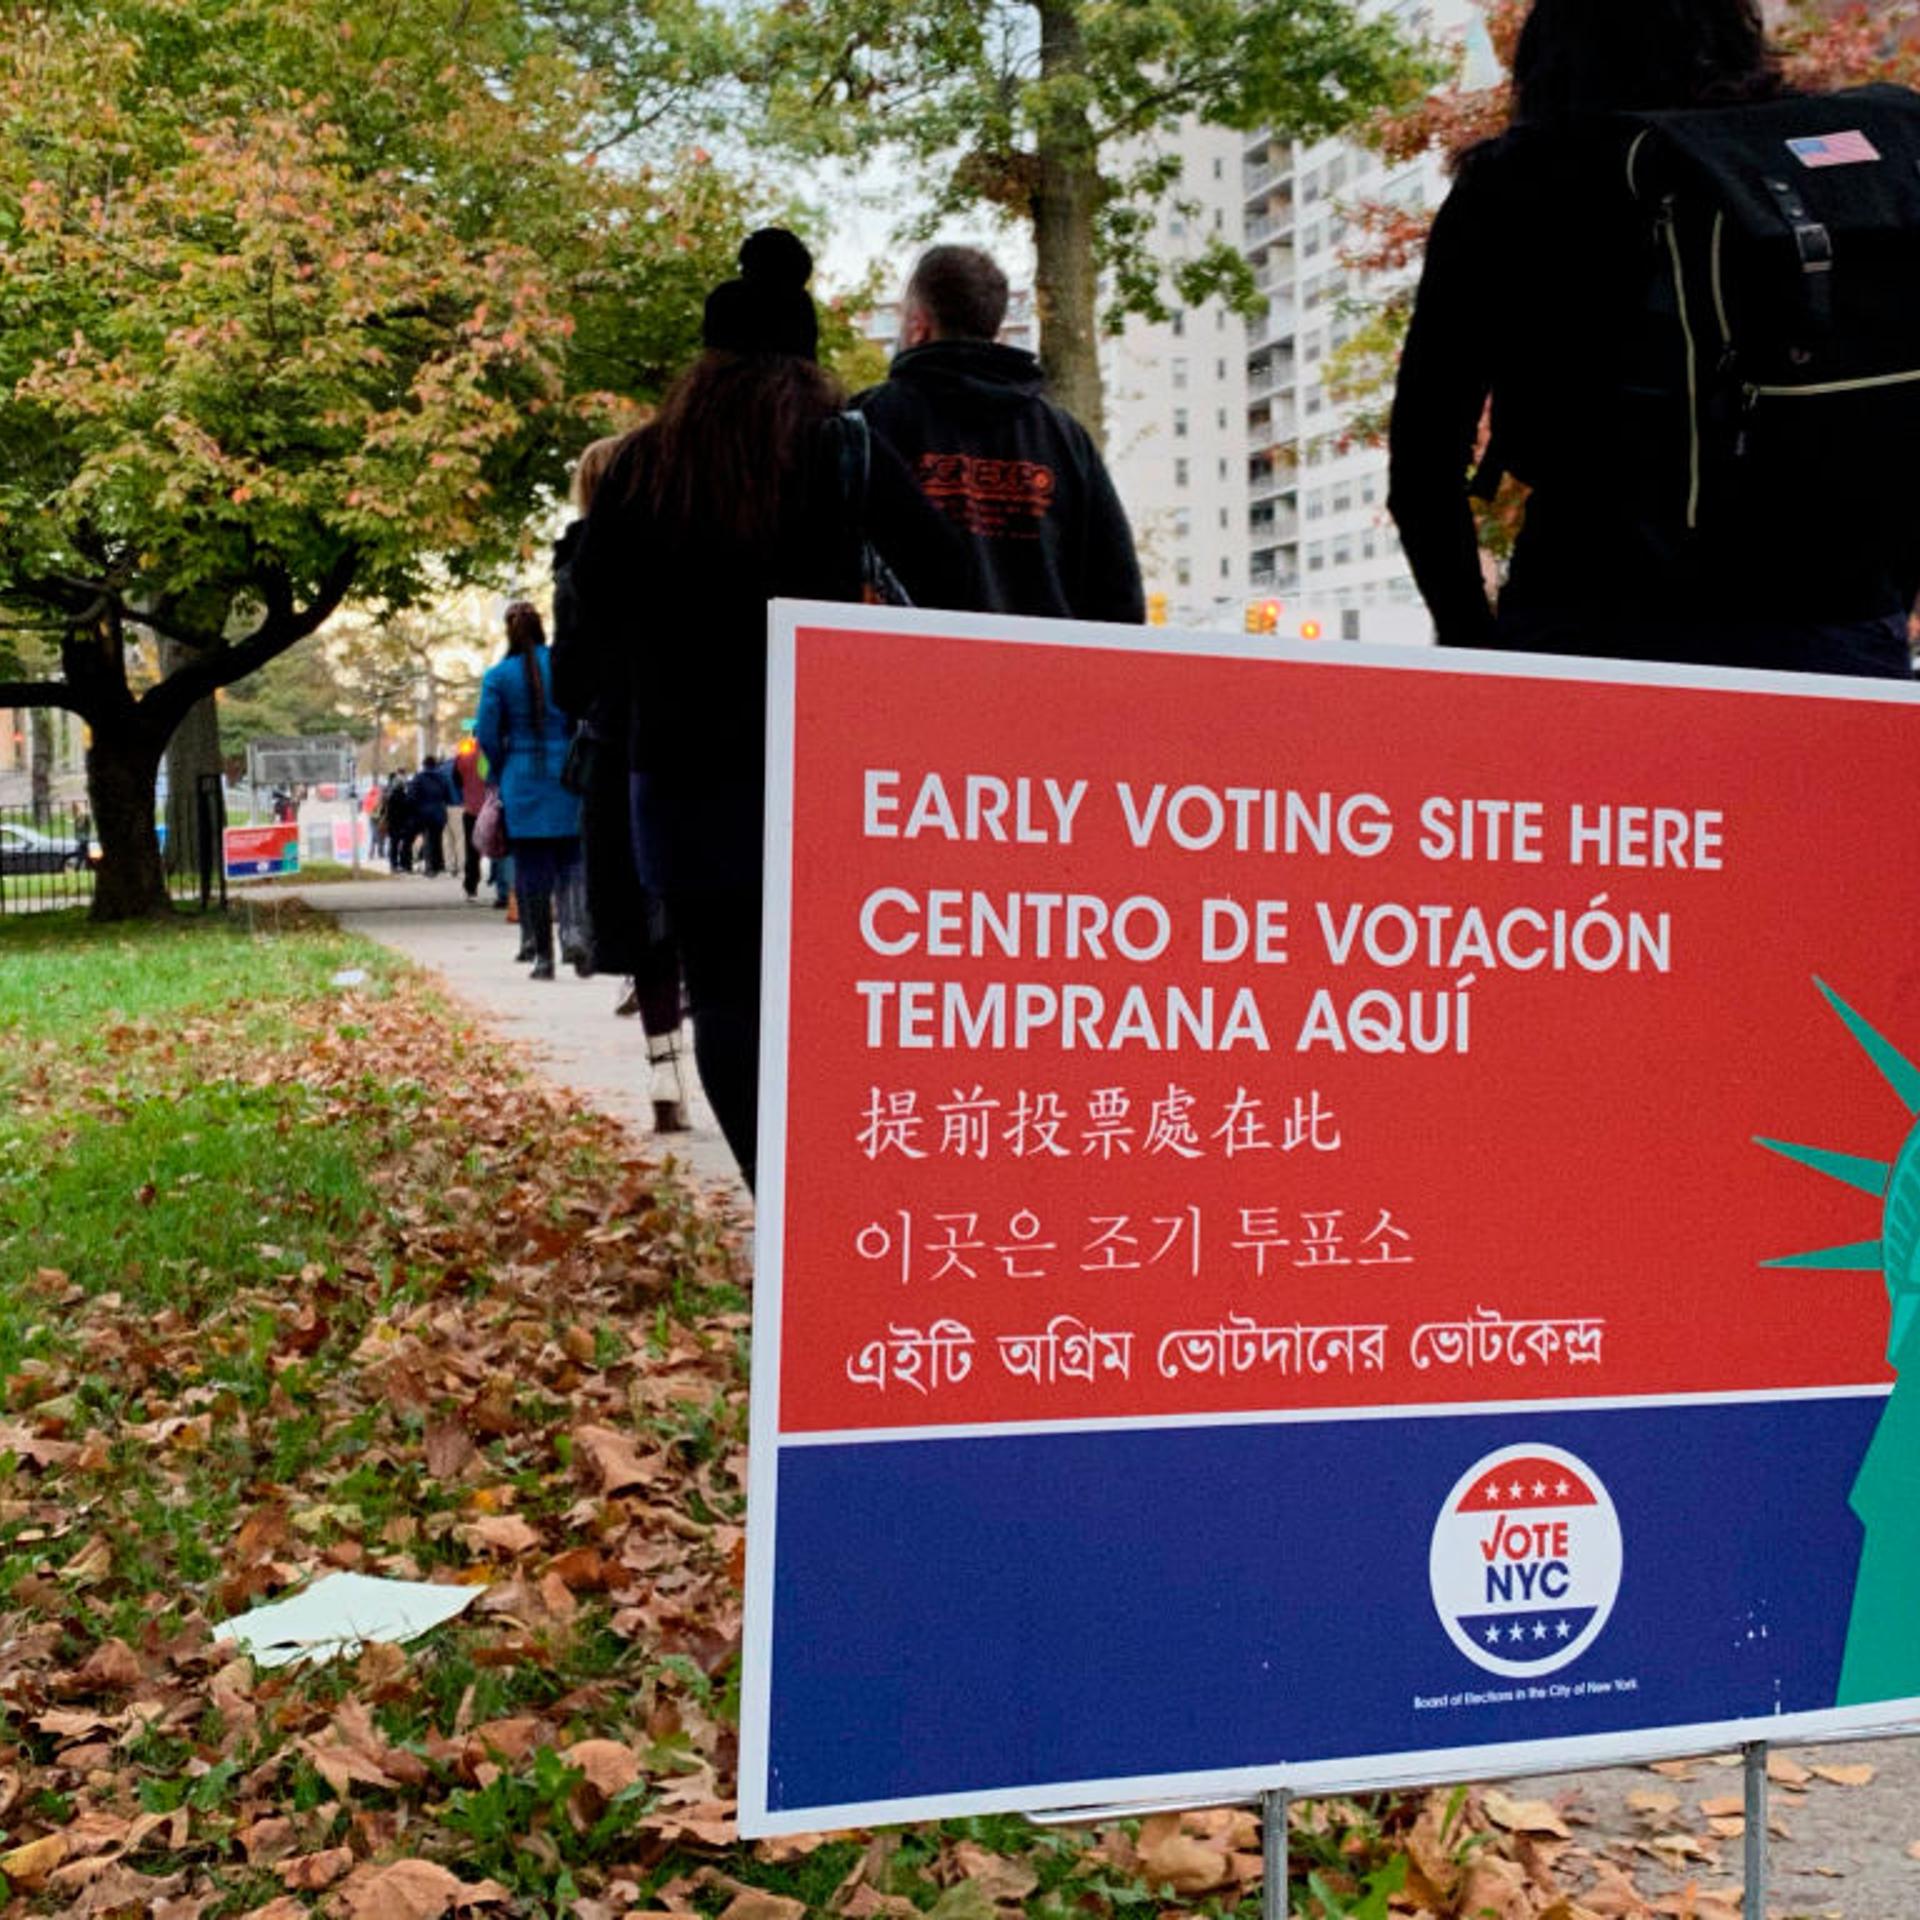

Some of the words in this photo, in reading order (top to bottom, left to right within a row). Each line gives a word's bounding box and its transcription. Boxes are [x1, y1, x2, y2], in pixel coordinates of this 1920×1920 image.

[864, 769, 1088, 844] EARLY
[1116, 782, 1393, 857] VOTING
[1419, 796, 1543, 863] SITE
[1570, 804, 1723, 870] HERE
[859, 887, 1171, 962] CENTRO
[1201, 895, 1288, 964] DE
[1315, 892, 1671, 973] VOTACIÓN
[855, 981, 1270, 1051] TEMPRANA
[1296, 972, 1476, 1054] AQUÍ
[856, 1084, 1342, 1160] 提前投票處在此
[855, 1208, 1057, 1285] 이곳은
[1079, 1205, 1201, 1277] 조기
[1231, 1206, 1414, 1277] 투표소
[846, 1317, 976, 1395] এইটি
[997, 1313, 1135, 1383] অগ্রিম
[1157, 1311, 1388, 1379] ভোটদানের
[1410, 1304, 1606, 1369] ভোটকেন্দ্র
[1480, 1514, 1569, 1561] VOTE
[1486, 1561, 1570, 1603] NYC
[1414, 1694, 1448, 1709] Board
[1450, 1694, 1463, 1706] of
[1464, 1690, 1513, 1705] Elections
[1516, 1689, 1526, 1699] in
[1528, 1687, 1546, 1698] the
[1549, 1684, 1571, 1698] City
[1574, 1682, 1586, 1695] of
[1587, 1681, 1611, 1693] New
[1614, 1678, 1638, 1691] York
